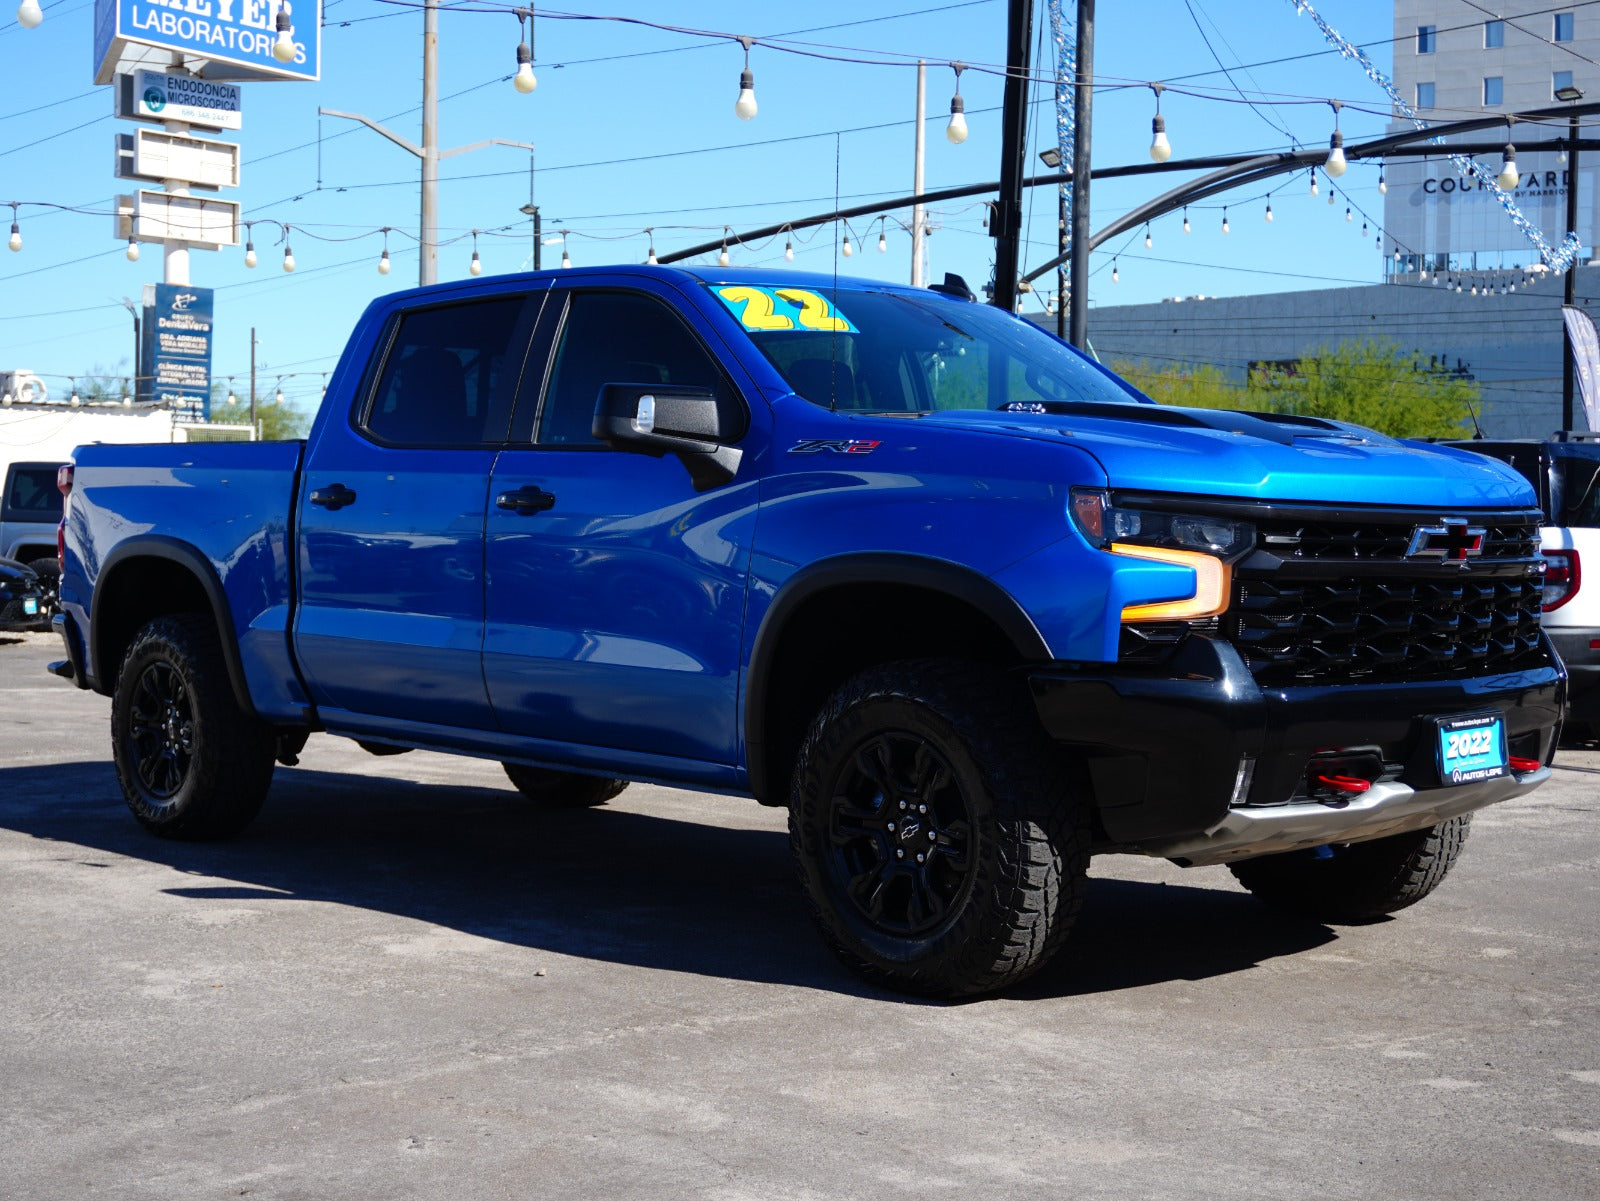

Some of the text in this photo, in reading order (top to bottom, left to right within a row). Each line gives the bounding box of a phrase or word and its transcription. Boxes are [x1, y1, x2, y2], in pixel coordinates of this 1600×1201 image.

[132, 4, 307, 64] LABORATORIS
[167, 77, 237, 100] ENDODONCIA
[167, 91, 236, 112] MICROSCOPICA
[718, 286, 850, 331] 22
[158, 317, 210, 332] DentalVera
[787, 439, 882, 454] ZR2
[1447, 730, 1491, 760] 2022
